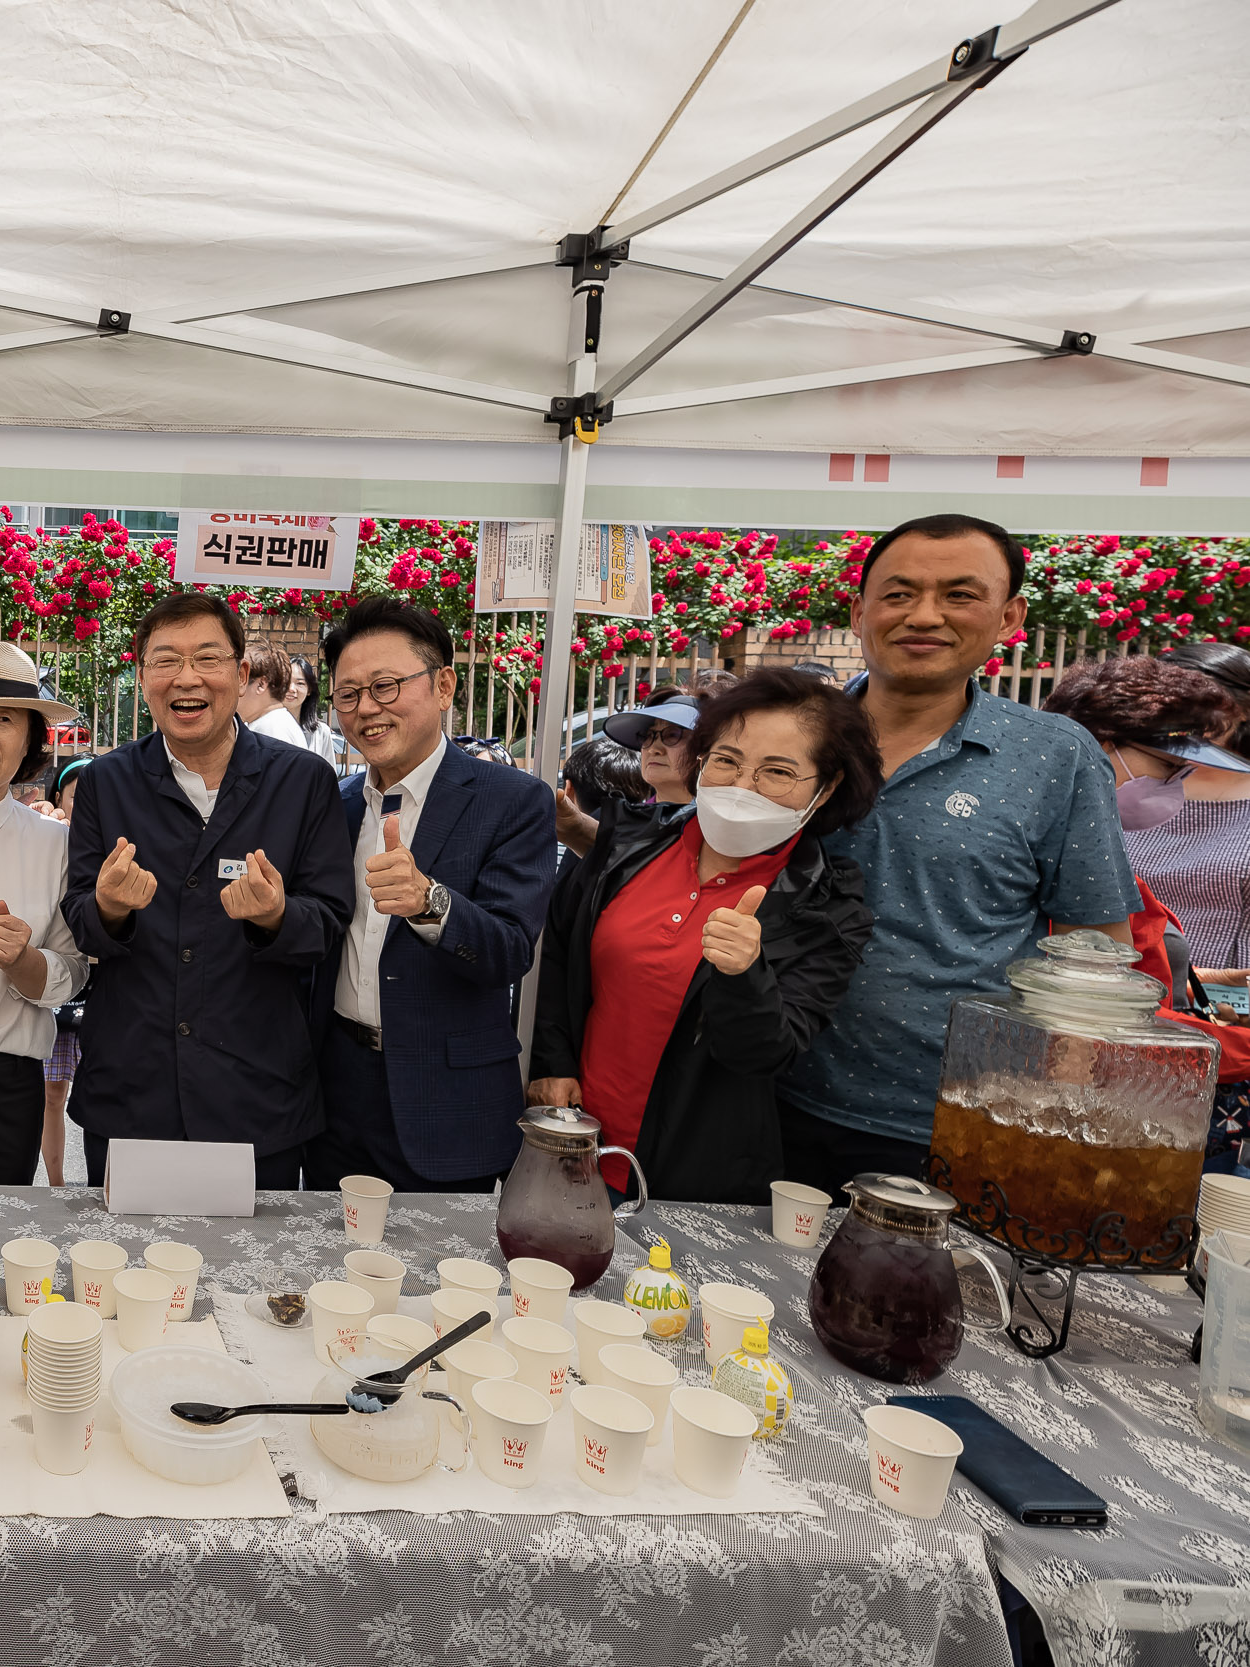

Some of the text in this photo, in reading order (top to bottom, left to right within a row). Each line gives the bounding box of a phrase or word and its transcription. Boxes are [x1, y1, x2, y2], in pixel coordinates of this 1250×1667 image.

[203, 533, 329, 570] 식권판매
[612, 573, 626, 600] 모집
[795, 1227, 810, 1236] king
[85, 1299, 100, 1308] king
[633, 1283, 689, 1311] LEMON
[503, 1458, 524, 1470] king
[586, 1457, 605, 1475] king
[879, 1474, 900, 1494] king
